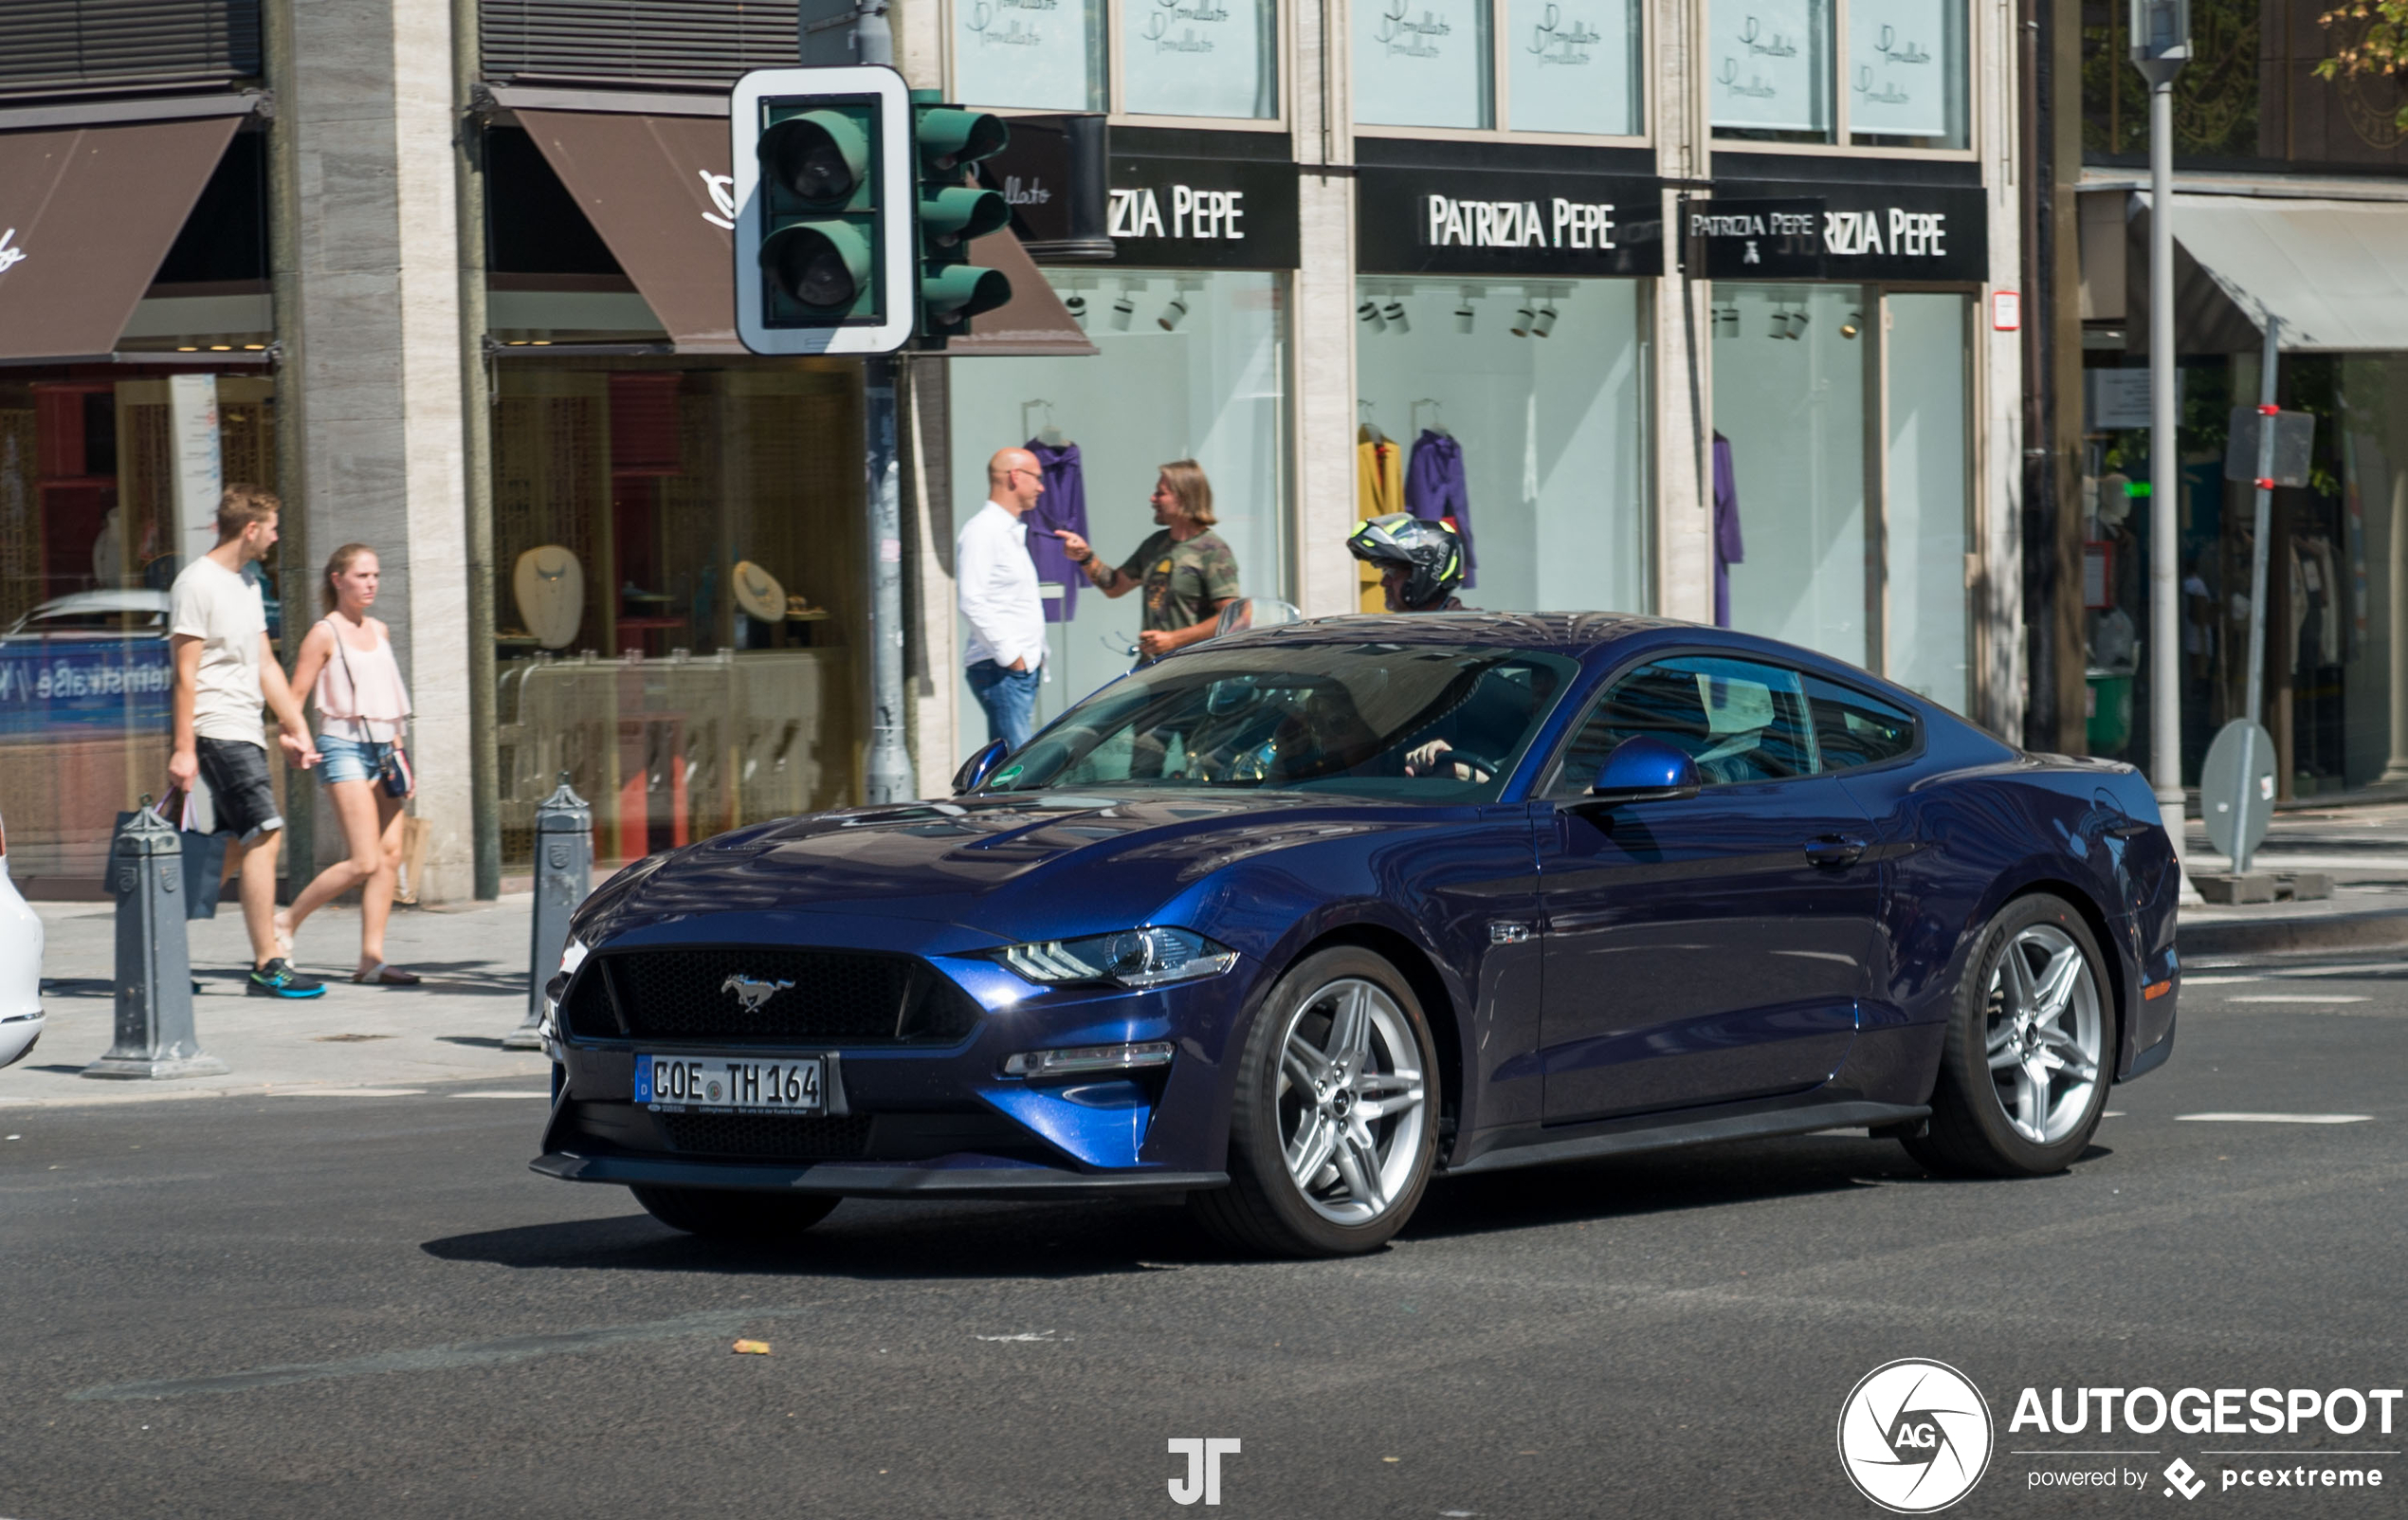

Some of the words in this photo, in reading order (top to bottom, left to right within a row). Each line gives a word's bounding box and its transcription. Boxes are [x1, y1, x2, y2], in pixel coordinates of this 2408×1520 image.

[1173, 185, 1244, 239] PEPE
[1429, 194, 1547, 247] PATRIZIA
[1552, 197, 1615, 248] PEPE
[1690, 213, 1766, 237] PATRIZIA
[1770, 211, 1815, 235] PEPE
[1888, 208, 1946, 256] PEPE
[640, 1084, 648, 1095] D
[654, 1061, 704, 1100] COE
